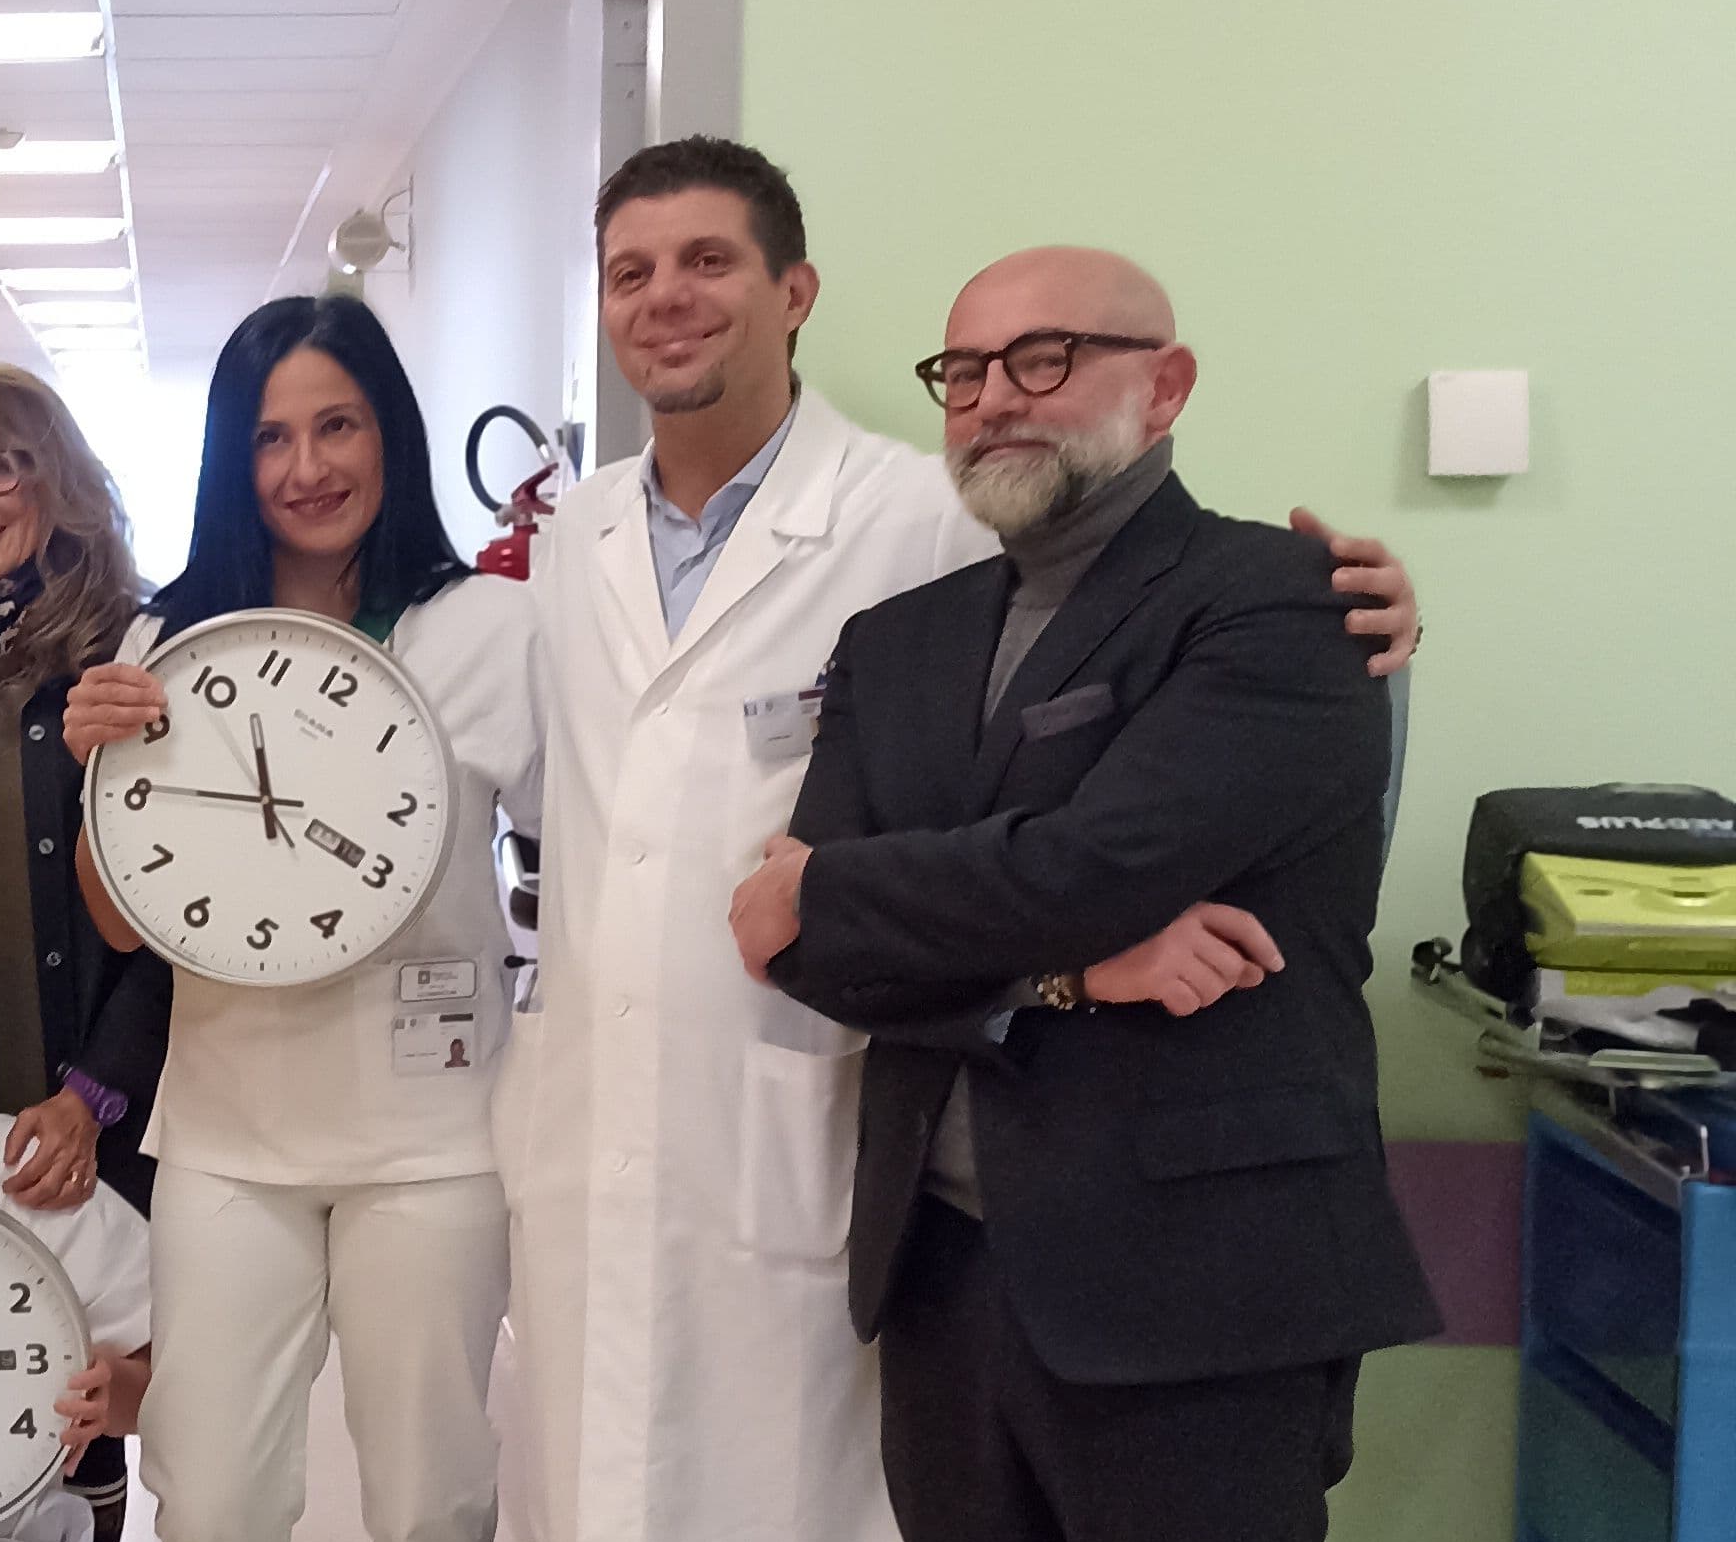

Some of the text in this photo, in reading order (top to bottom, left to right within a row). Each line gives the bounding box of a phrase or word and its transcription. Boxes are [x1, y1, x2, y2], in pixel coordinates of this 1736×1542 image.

[258, 650, 291, 686] 11
[192, 666, 236, 708] 10
[319, 666, 357, 707] 12
[142, 713, 171, 745] 9
[376, 725, 397, 753] 1
[124, 777, 152, 811] 8
[387, 793, 417, 827] 2
[141, 844, 173, 873] 7
[362, 854, 393, 888] 3
[184, 896, 210, 928] 6
[310, 910, 343, 939] 4
[247, 918, 279, 950] 5
[10, 1283, 32, 1313] 2
[26, 1344, 48, 1374] 3
[10, 1408, 37, 1439] 4
